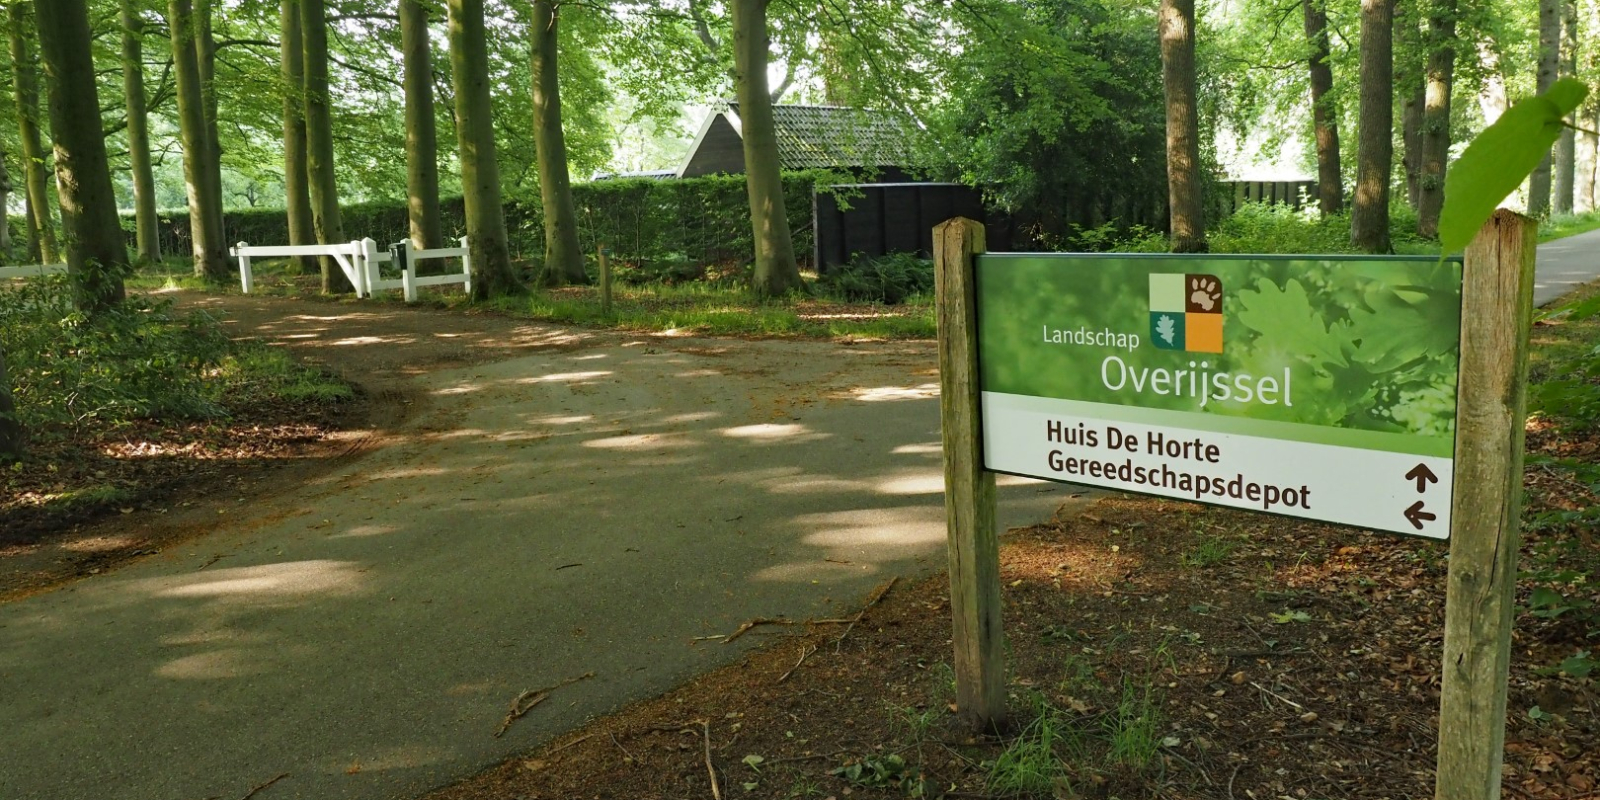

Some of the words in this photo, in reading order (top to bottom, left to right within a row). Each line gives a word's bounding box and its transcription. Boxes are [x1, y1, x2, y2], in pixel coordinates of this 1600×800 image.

[1042, 325, 1140, 352] Landschap
[1101, 356, 1292, 407] Overijssel
[1046, 420, 1098, 448] Huis
[1106, 427, 1138, 452] De
[1146, 431, 1220, 464] Horte
[1048, 449, 1311, 510] Gereedschapsdepot
